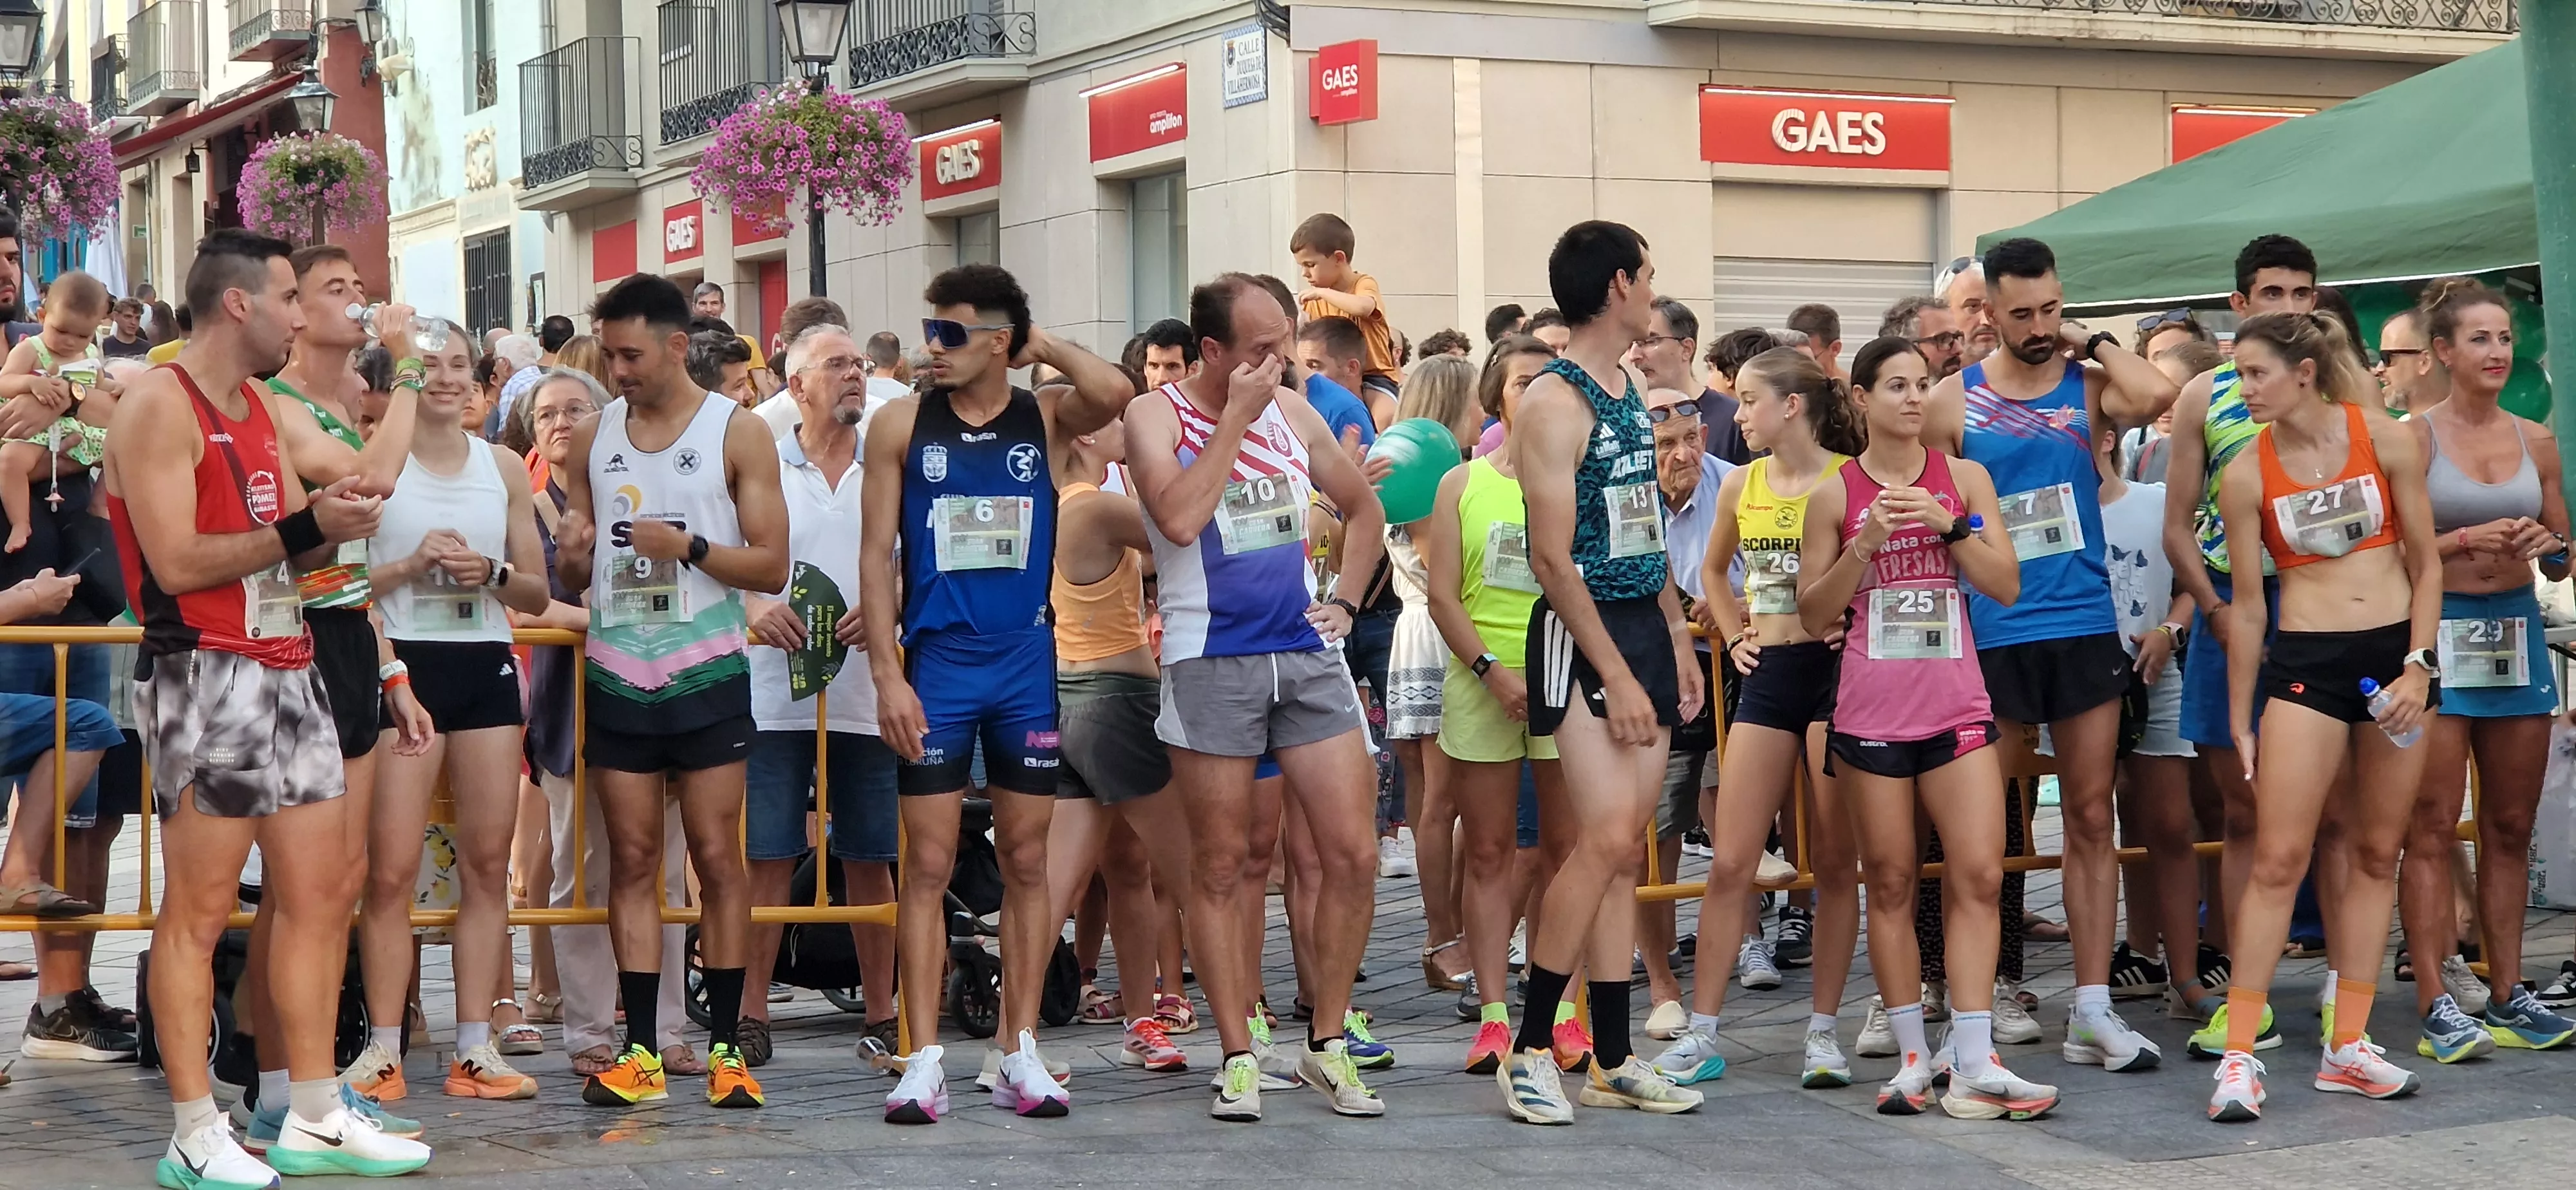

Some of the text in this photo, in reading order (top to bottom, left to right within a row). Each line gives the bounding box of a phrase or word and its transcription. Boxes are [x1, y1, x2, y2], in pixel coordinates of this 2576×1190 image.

[1238, 37, 1260, 57] CALLE
[1236, 55, 1262, 76] DUQUESA DE
[1227, 73, 1261, 95] VILLAHERMOSA
[1322, 64, 1358, 91] GAES
[1150, 112, 1182, 135] amplifon
[1772, 108, 1886, 155] GAES
[936, 138, 982, 185] GAES
[666, 216, 697, 252] GAES
[1240, 478, 1276, 505] 10
[1629, 486, 1647, 509] 13
[2306, 484, 2344, 515] 27
[975, 499, 995, 523] 6
[2018, 493, 2036, 515] 7
[1880, 535, 1919, 554] Nata
[277, 560, 290, 586] 4
[634, 556, 652, 579] 9
[1766, 552, 1799, 574] 26
[1878, 547, 1947, 582] FRESAS
[807, 605, 815, 614] de
[1898, 590, 1935, 614] 25
[2468, 620, 2504, 643] 29
